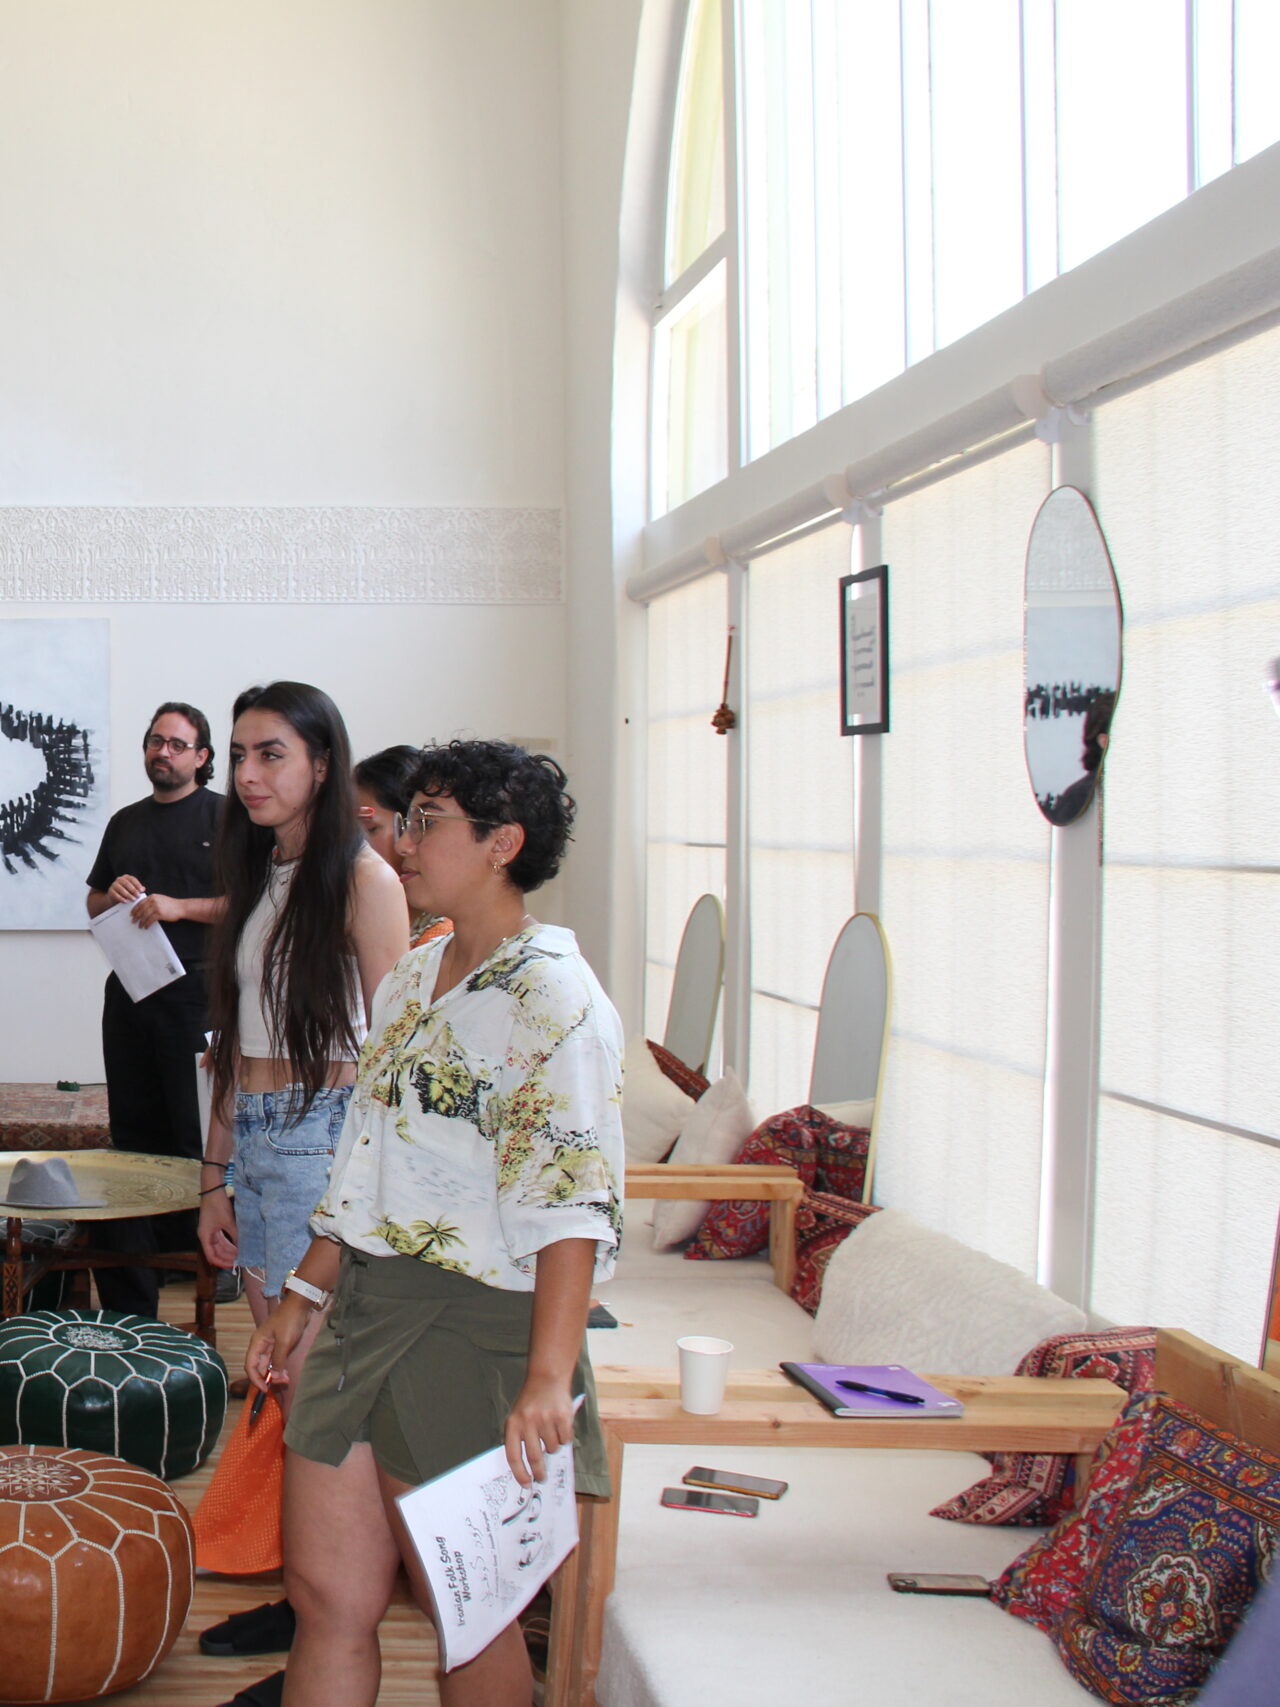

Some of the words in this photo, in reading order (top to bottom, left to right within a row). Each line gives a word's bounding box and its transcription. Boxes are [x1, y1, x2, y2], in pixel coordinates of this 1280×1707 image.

[435, 1536, 452, 1564] Song
[445, 1565, 458, 1589] Folk
[454, 1550, 472, 1602] Workshop
[454, 1589, 466, 1627] Iranian
